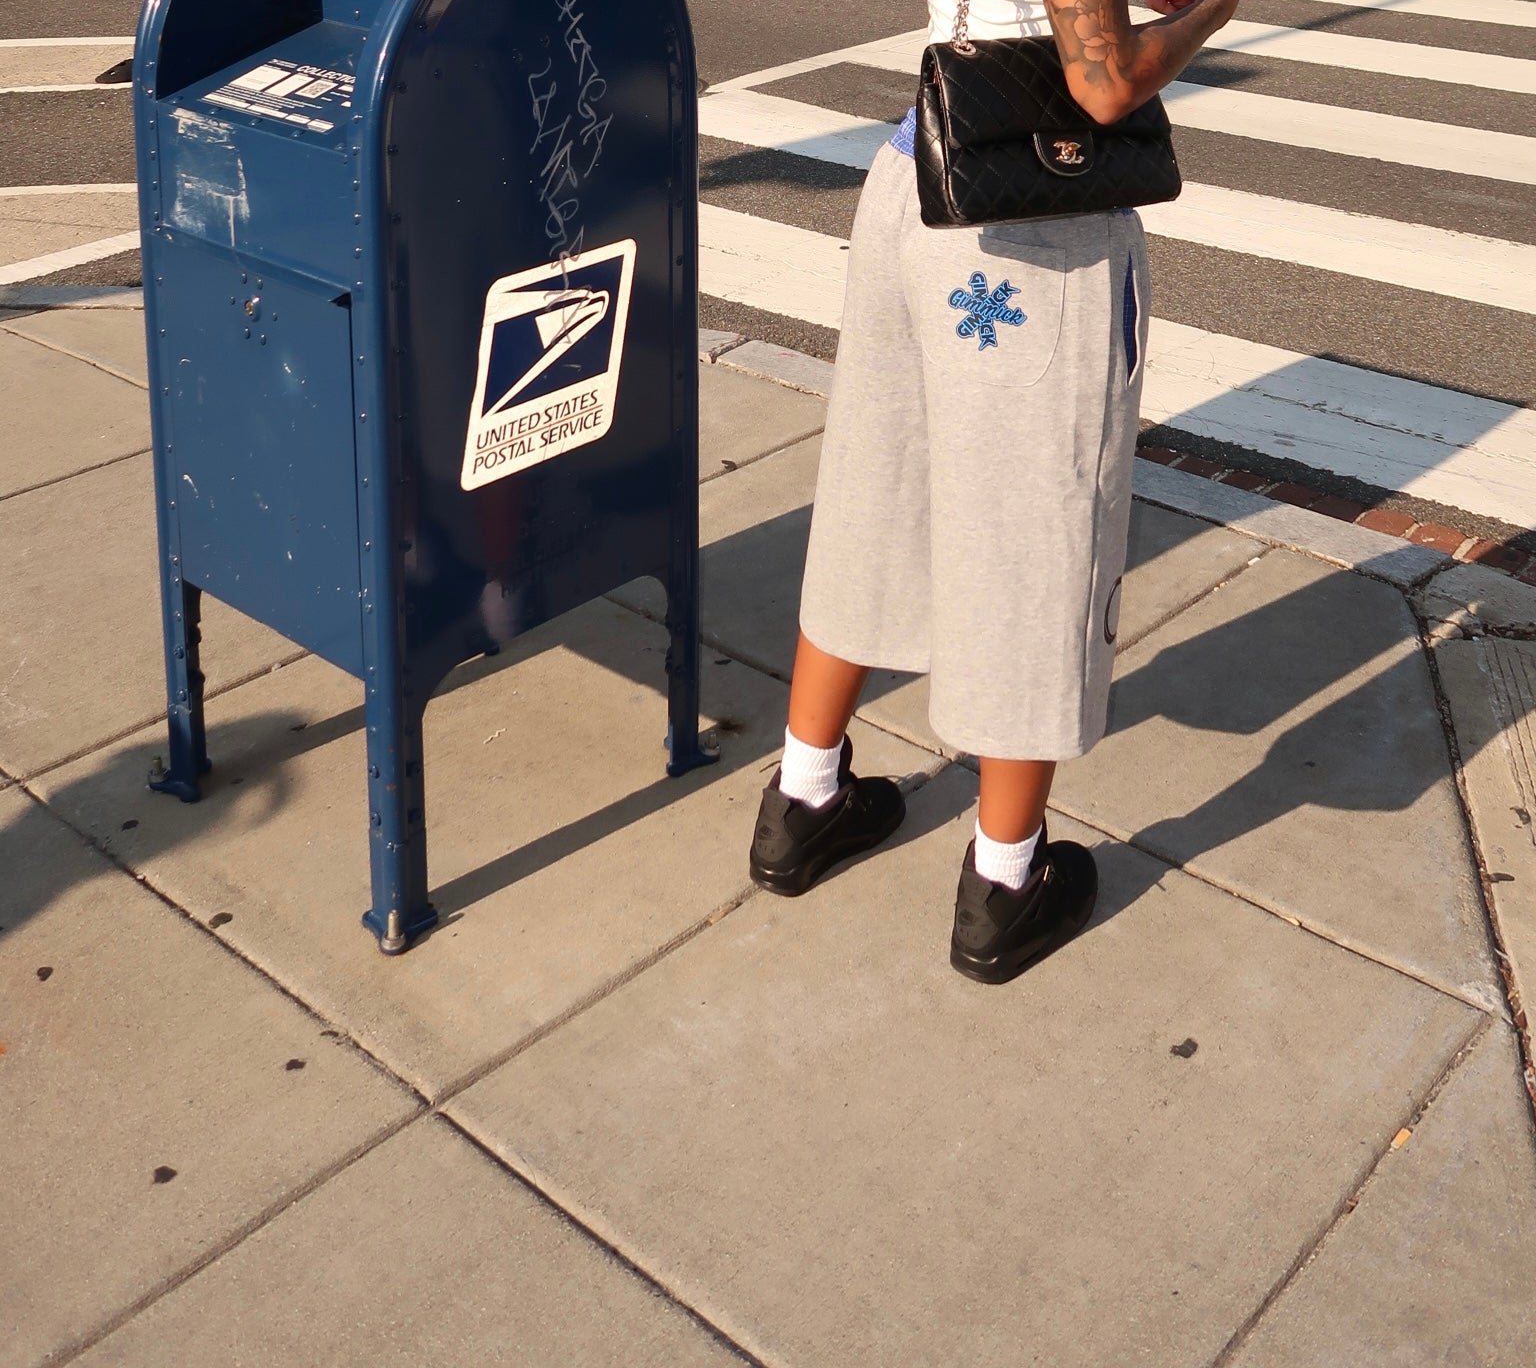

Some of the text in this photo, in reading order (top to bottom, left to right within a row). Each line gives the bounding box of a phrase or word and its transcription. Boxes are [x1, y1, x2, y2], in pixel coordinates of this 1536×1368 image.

[297, 65, 357, 84] COLLECTIO
[949, 288, 1027, 326] Gimmick
[472, 409, 604, 475] POSTAL SERVICE
[476, 389, 599, 450] UNITED STATES
